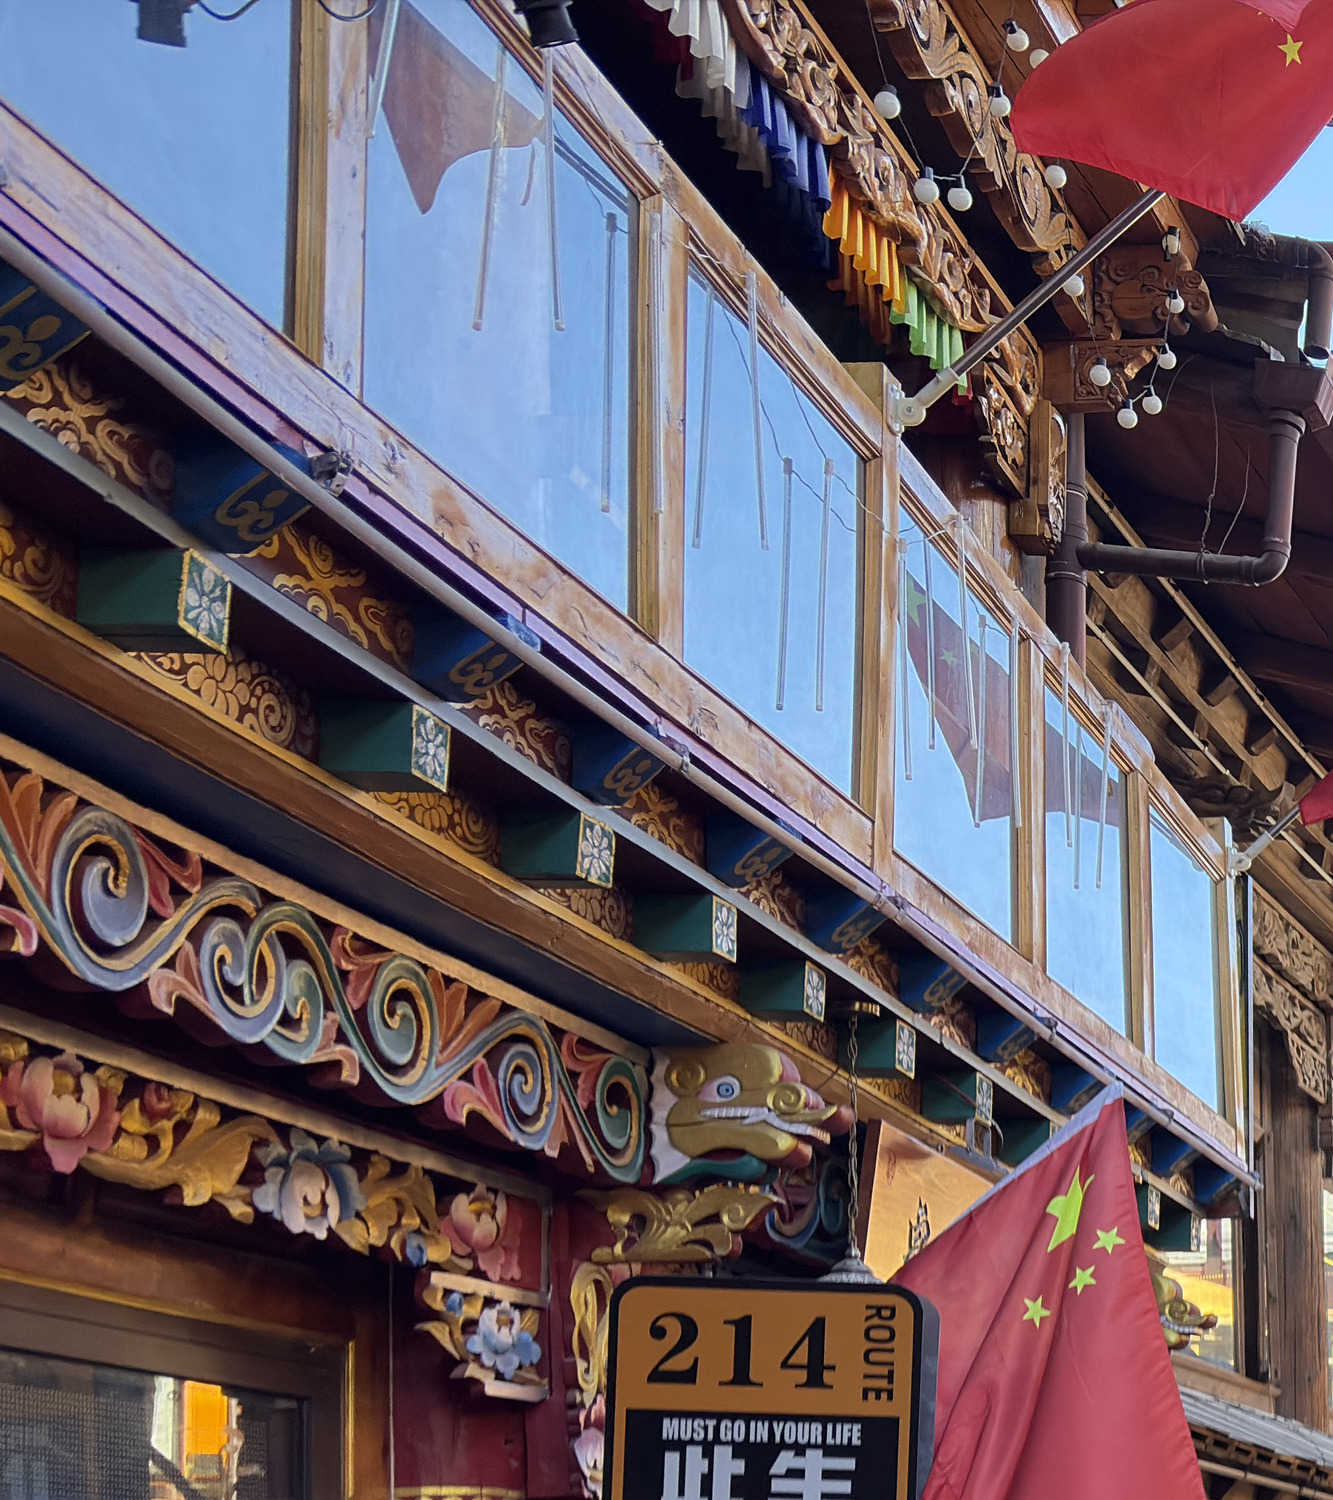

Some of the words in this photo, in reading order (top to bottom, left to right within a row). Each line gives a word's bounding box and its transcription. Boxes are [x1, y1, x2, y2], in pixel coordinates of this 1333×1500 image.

[647, 1312, 836, 1390] 214
[862, 1304, 896, 1402] ROUTE
[662, 1417, 717, 1441] MUST
[720, 1420, 746, 1442] GO
[749, 1420, 769, 1443] IN
[772, 1421, 822, 1445] YOUR
[826, 1423, 862, 1446] LIFE
